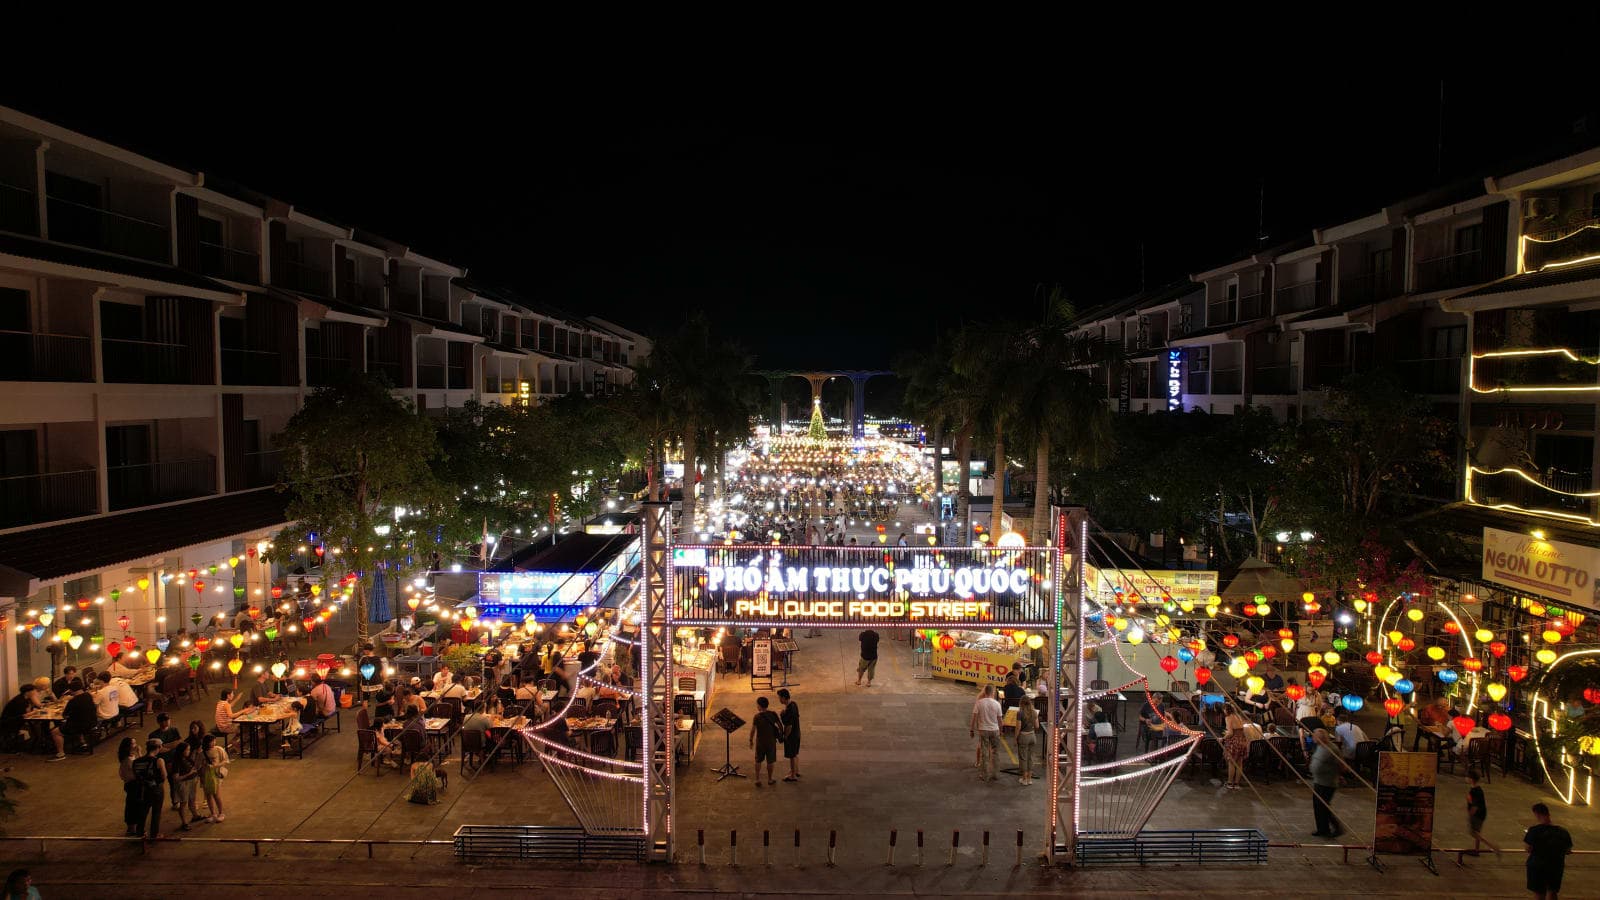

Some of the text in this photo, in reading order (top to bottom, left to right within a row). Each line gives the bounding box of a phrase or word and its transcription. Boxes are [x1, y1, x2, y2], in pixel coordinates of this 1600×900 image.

[707, 555, 763, 592] PHỐ
[813, 562, 889, 598] THỰC
[953, 560, 1029, 598] QUỐC
[1485, 547, 1531, 576] NGON
[1535, 560, 1589, 588] OTTO
[735, 600, 992, 618] PHU QUOC FOOD STREET
[948, 668, 963, 676] HOT
[965, 671, 979, 679] POT
[959, 659, 1009, 676] OTTO
